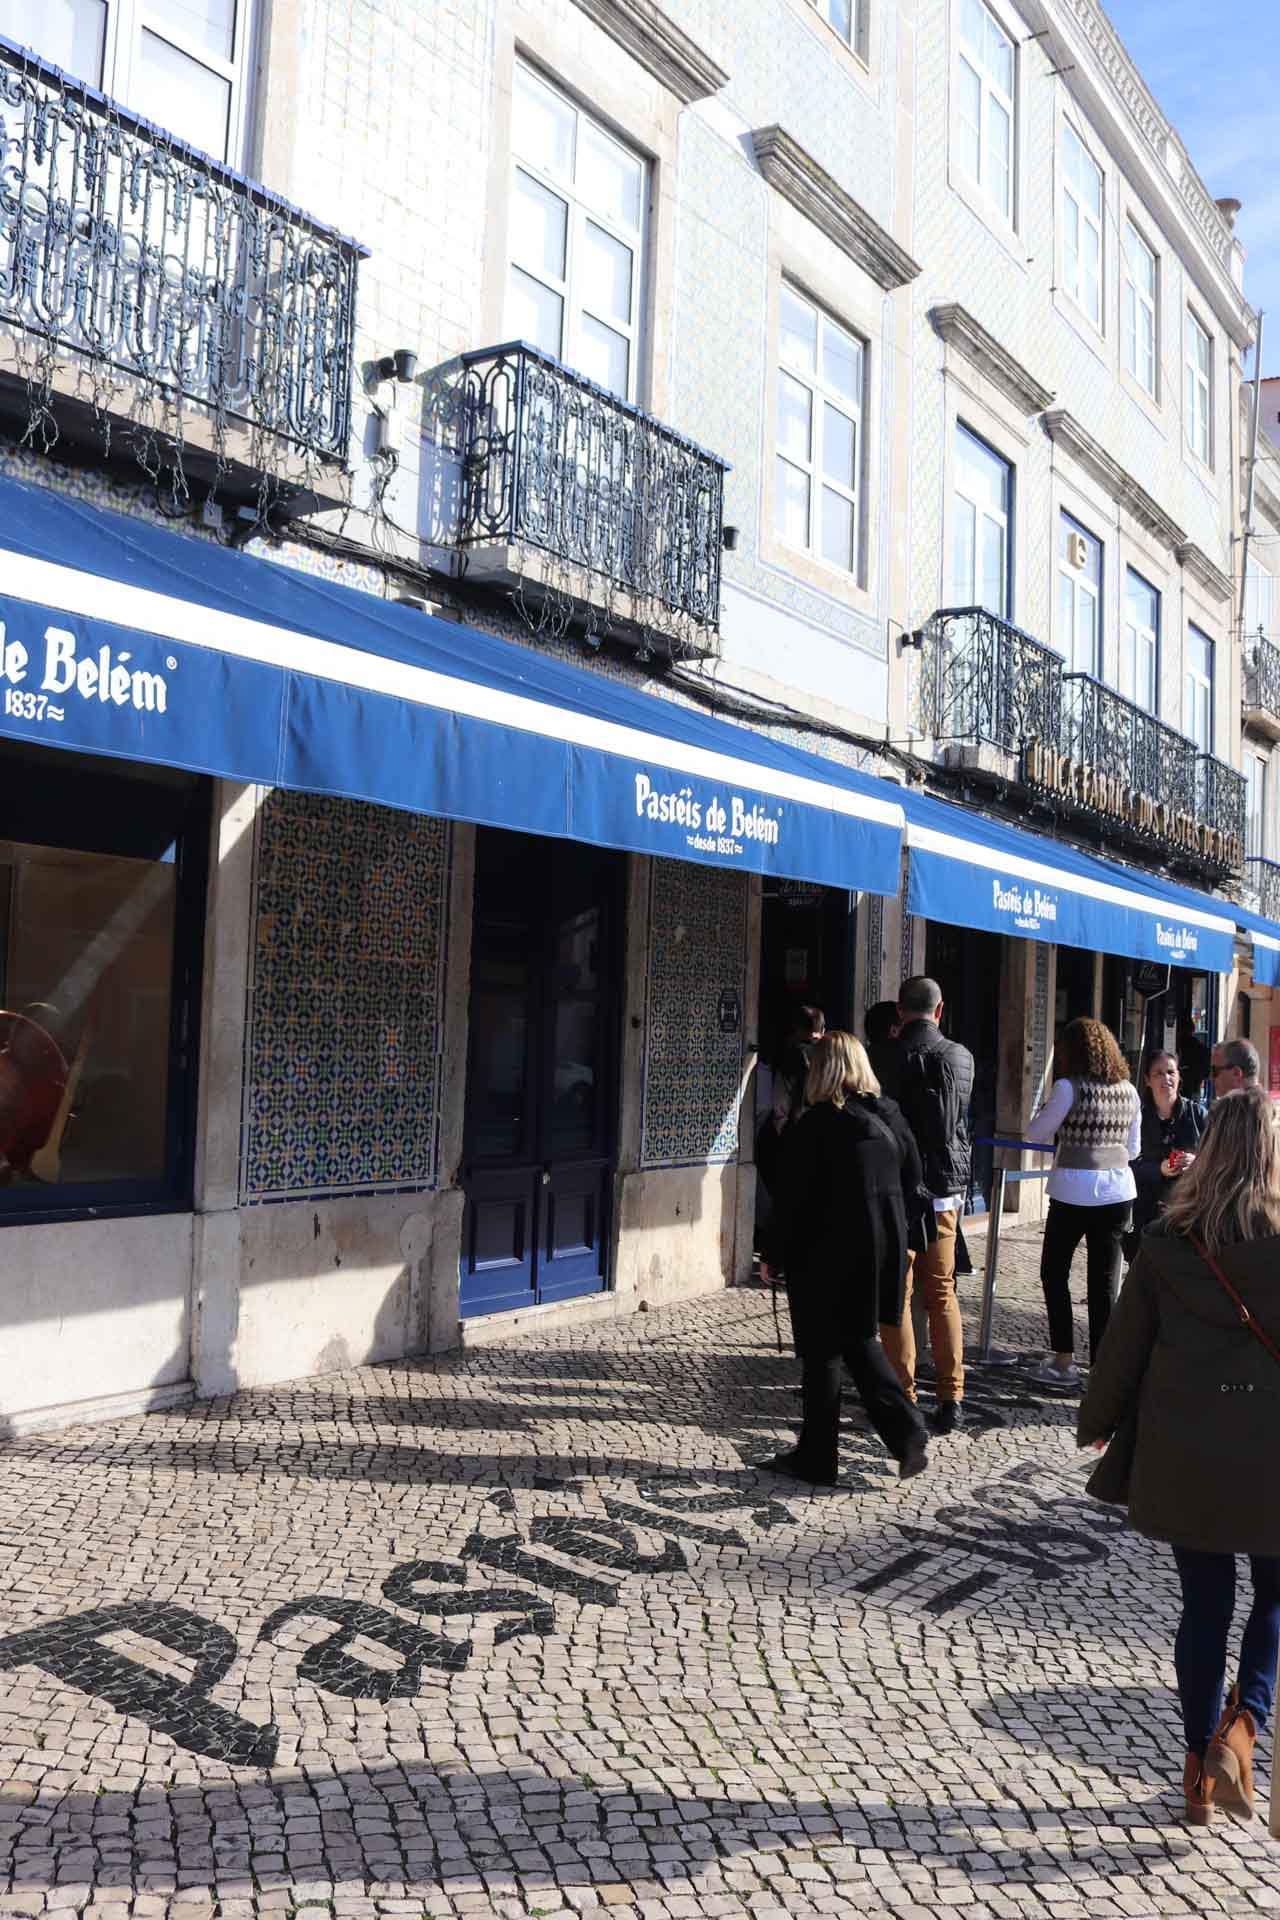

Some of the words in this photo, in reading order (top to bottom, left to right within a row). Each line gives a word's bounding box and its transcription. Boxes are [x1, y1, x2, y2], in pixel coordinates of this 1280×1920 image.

[41, 626, 167, 713] Belém
[5, 688, 48, 721] 1837
[635, 773, 701, 829] Pastéis
[706, 796, 727, 833] de
[731, 796, 779, 844] Belém
[694, 834, 716, 851] desde
[717, 837, 734, 854] 1837
